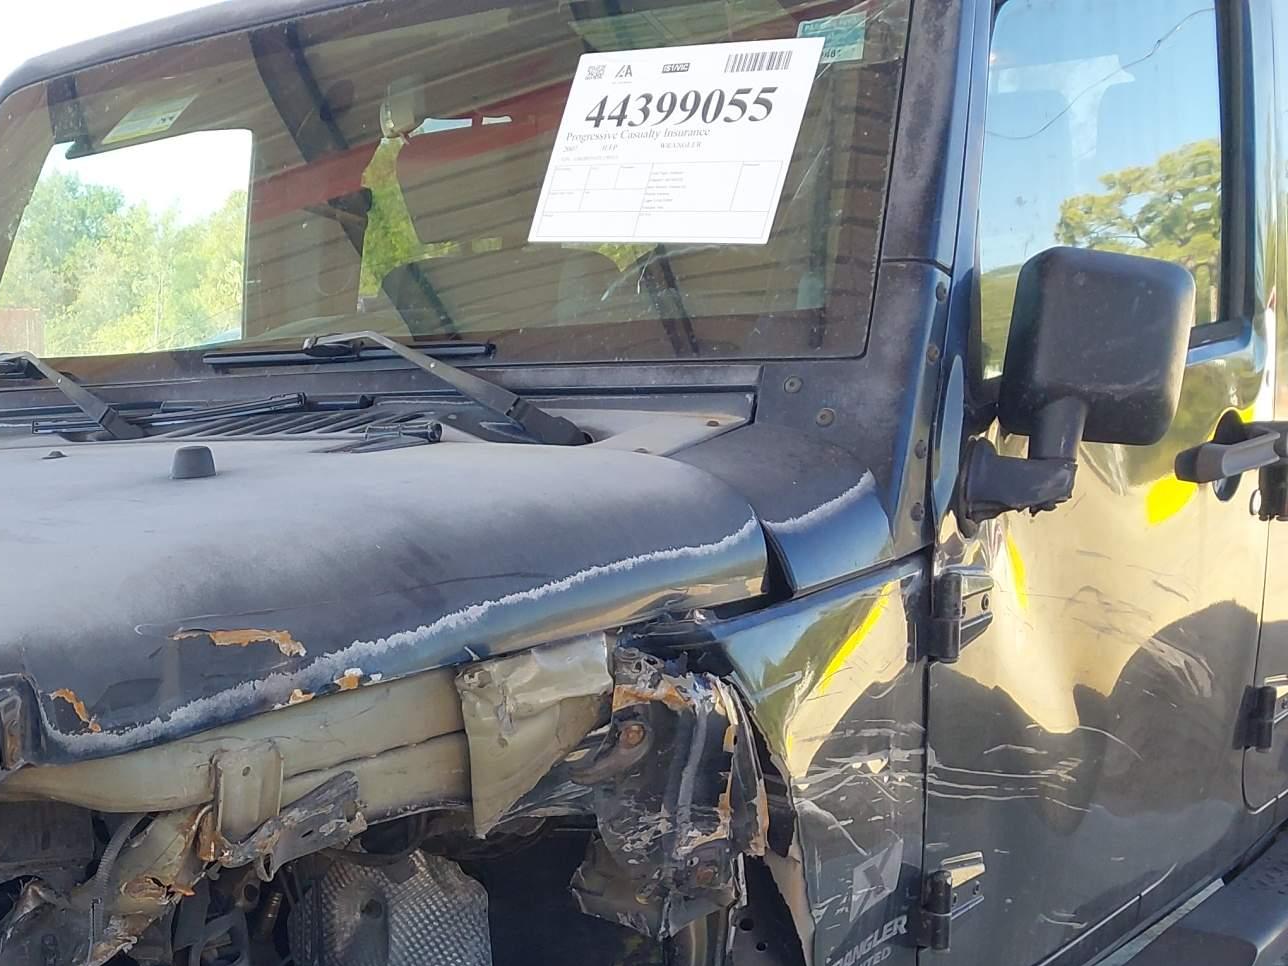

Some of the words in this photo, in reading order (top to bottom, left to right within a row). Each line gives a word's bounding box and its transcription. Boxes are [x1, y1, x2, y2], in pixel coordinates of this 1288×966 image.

[584, 86, 779, 128] 44399055
[565, 130, 618, 143] Progressive
[619, 128, 661, 141] Casualty
[663, 127, 711, 138] Insurance
